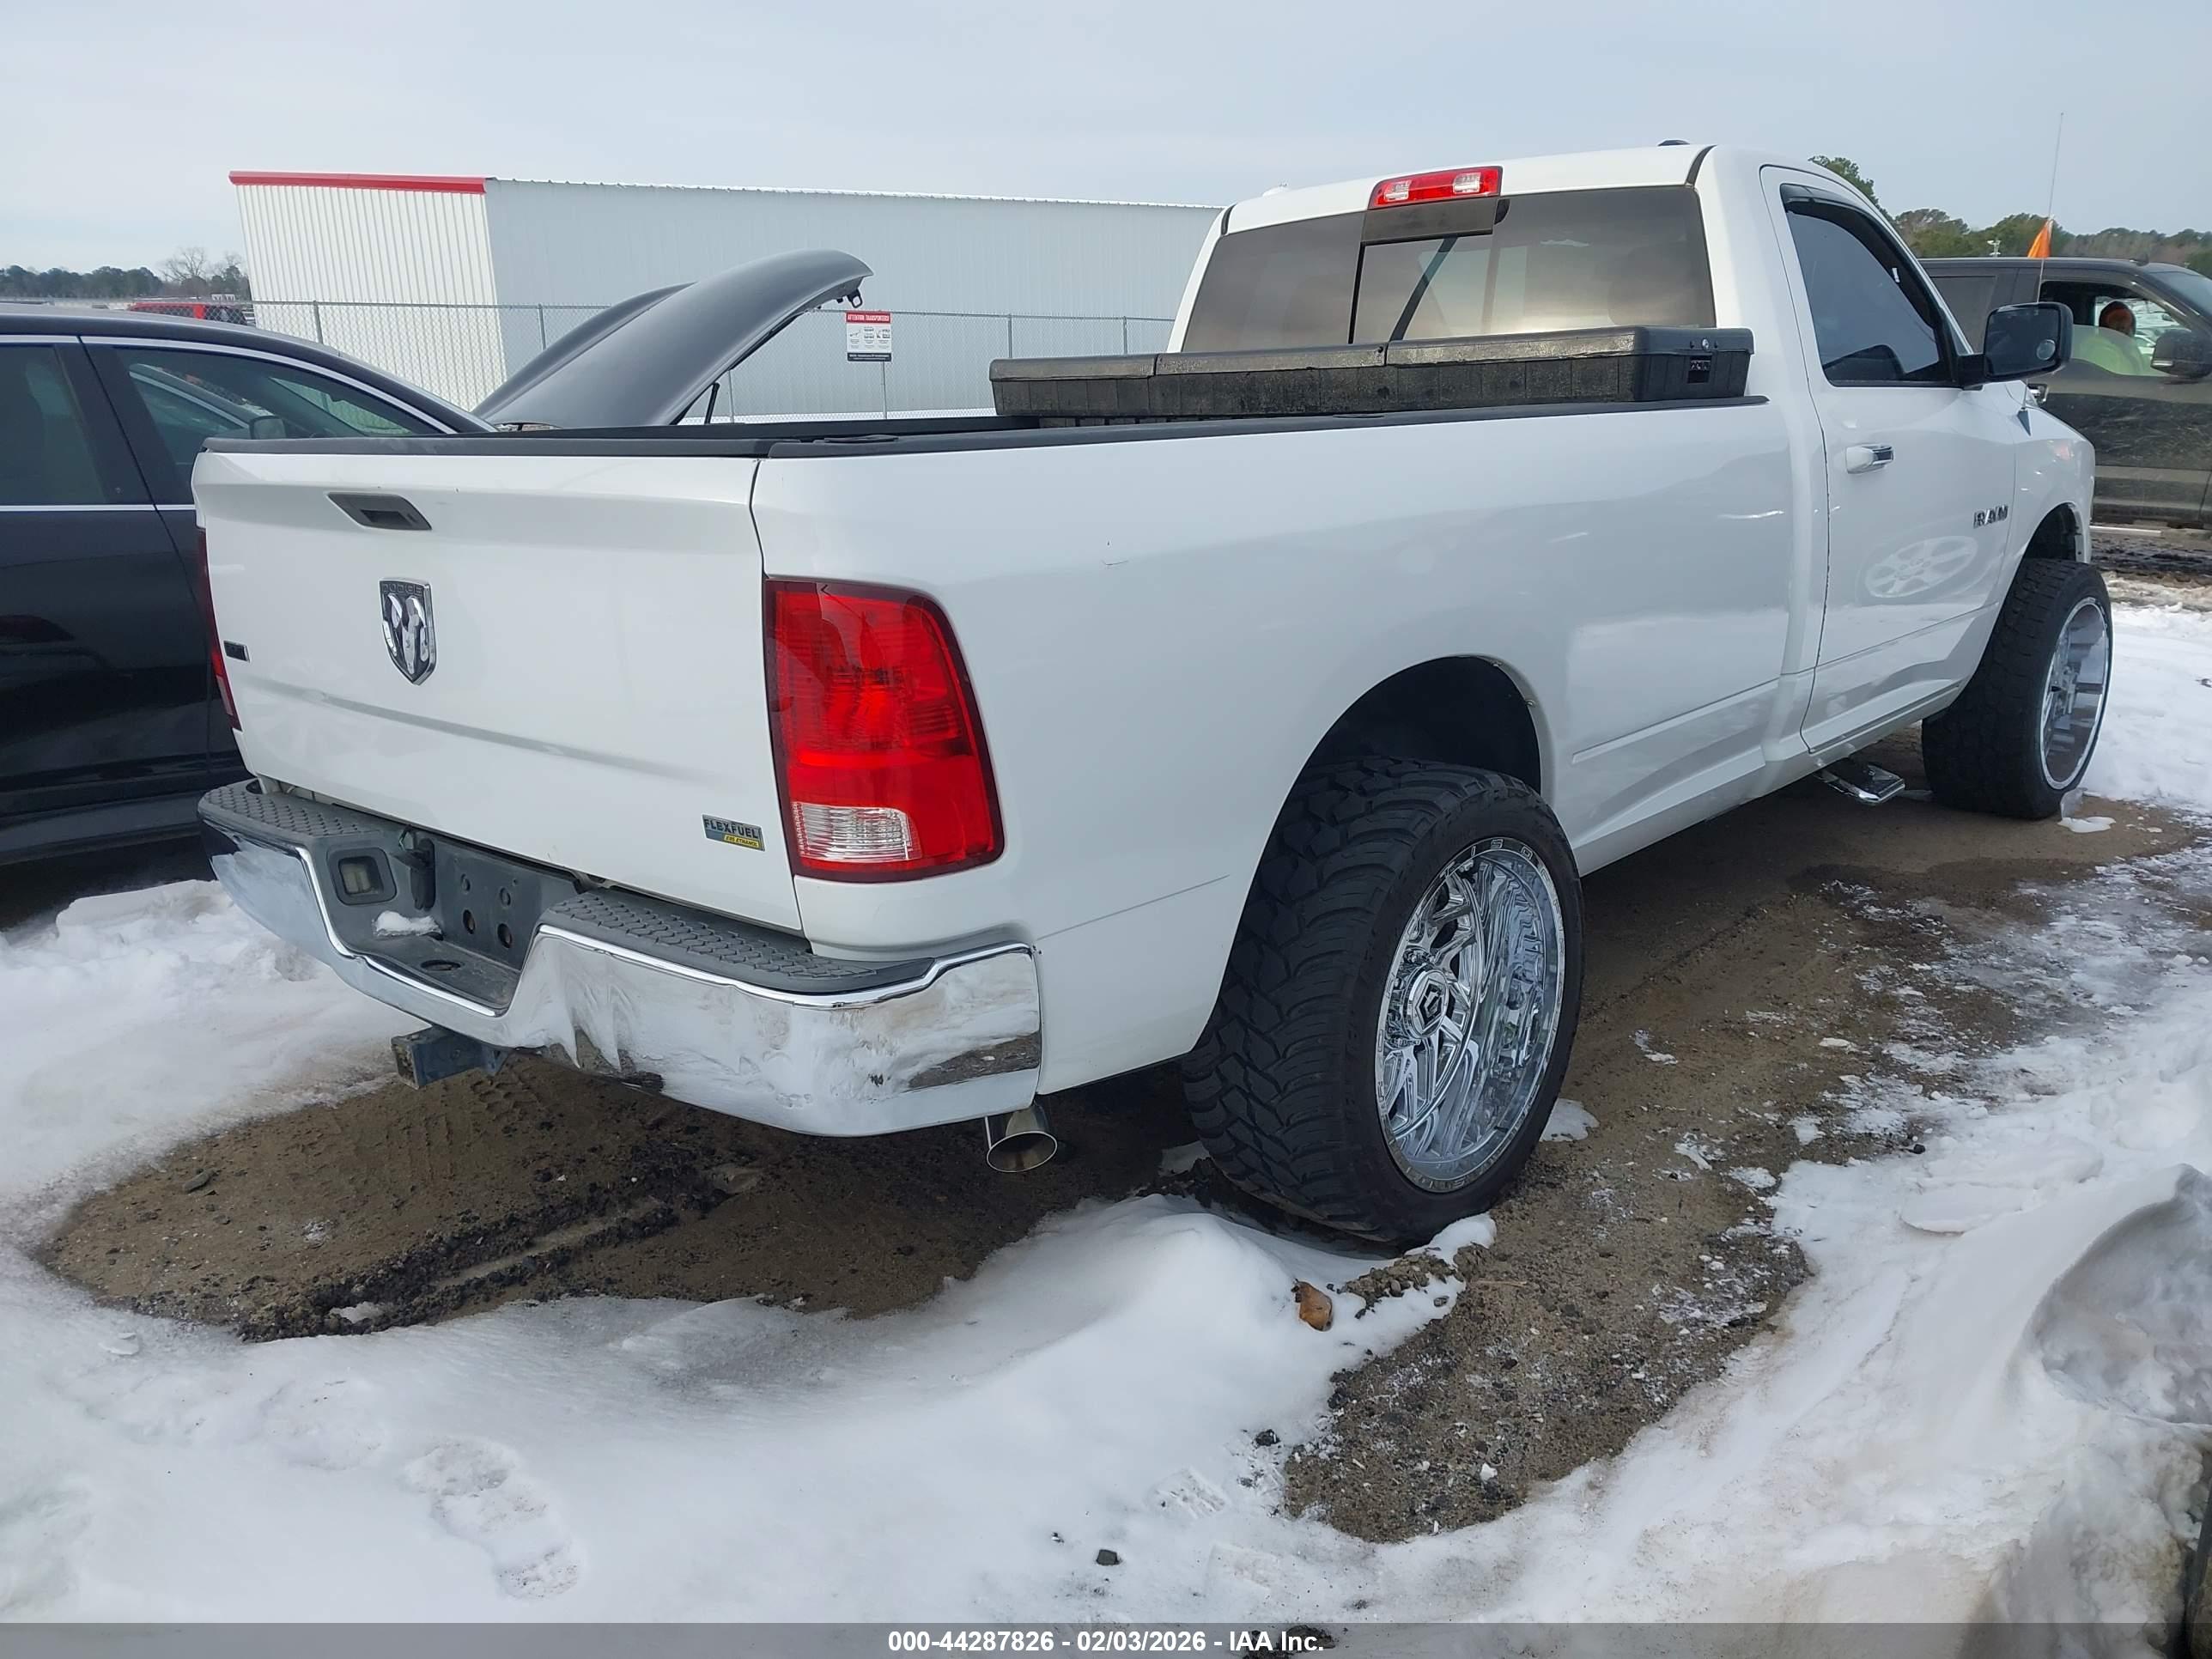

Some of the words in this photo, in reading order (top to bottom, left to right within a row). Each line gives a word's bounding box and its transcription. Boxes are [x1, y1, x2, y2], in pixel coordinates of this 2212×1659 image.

[1973, 504, 2009, 529] RAM
[382, 582, 423, 596] DODGE
[703, 818, 759, 839] FLEXFUEL
